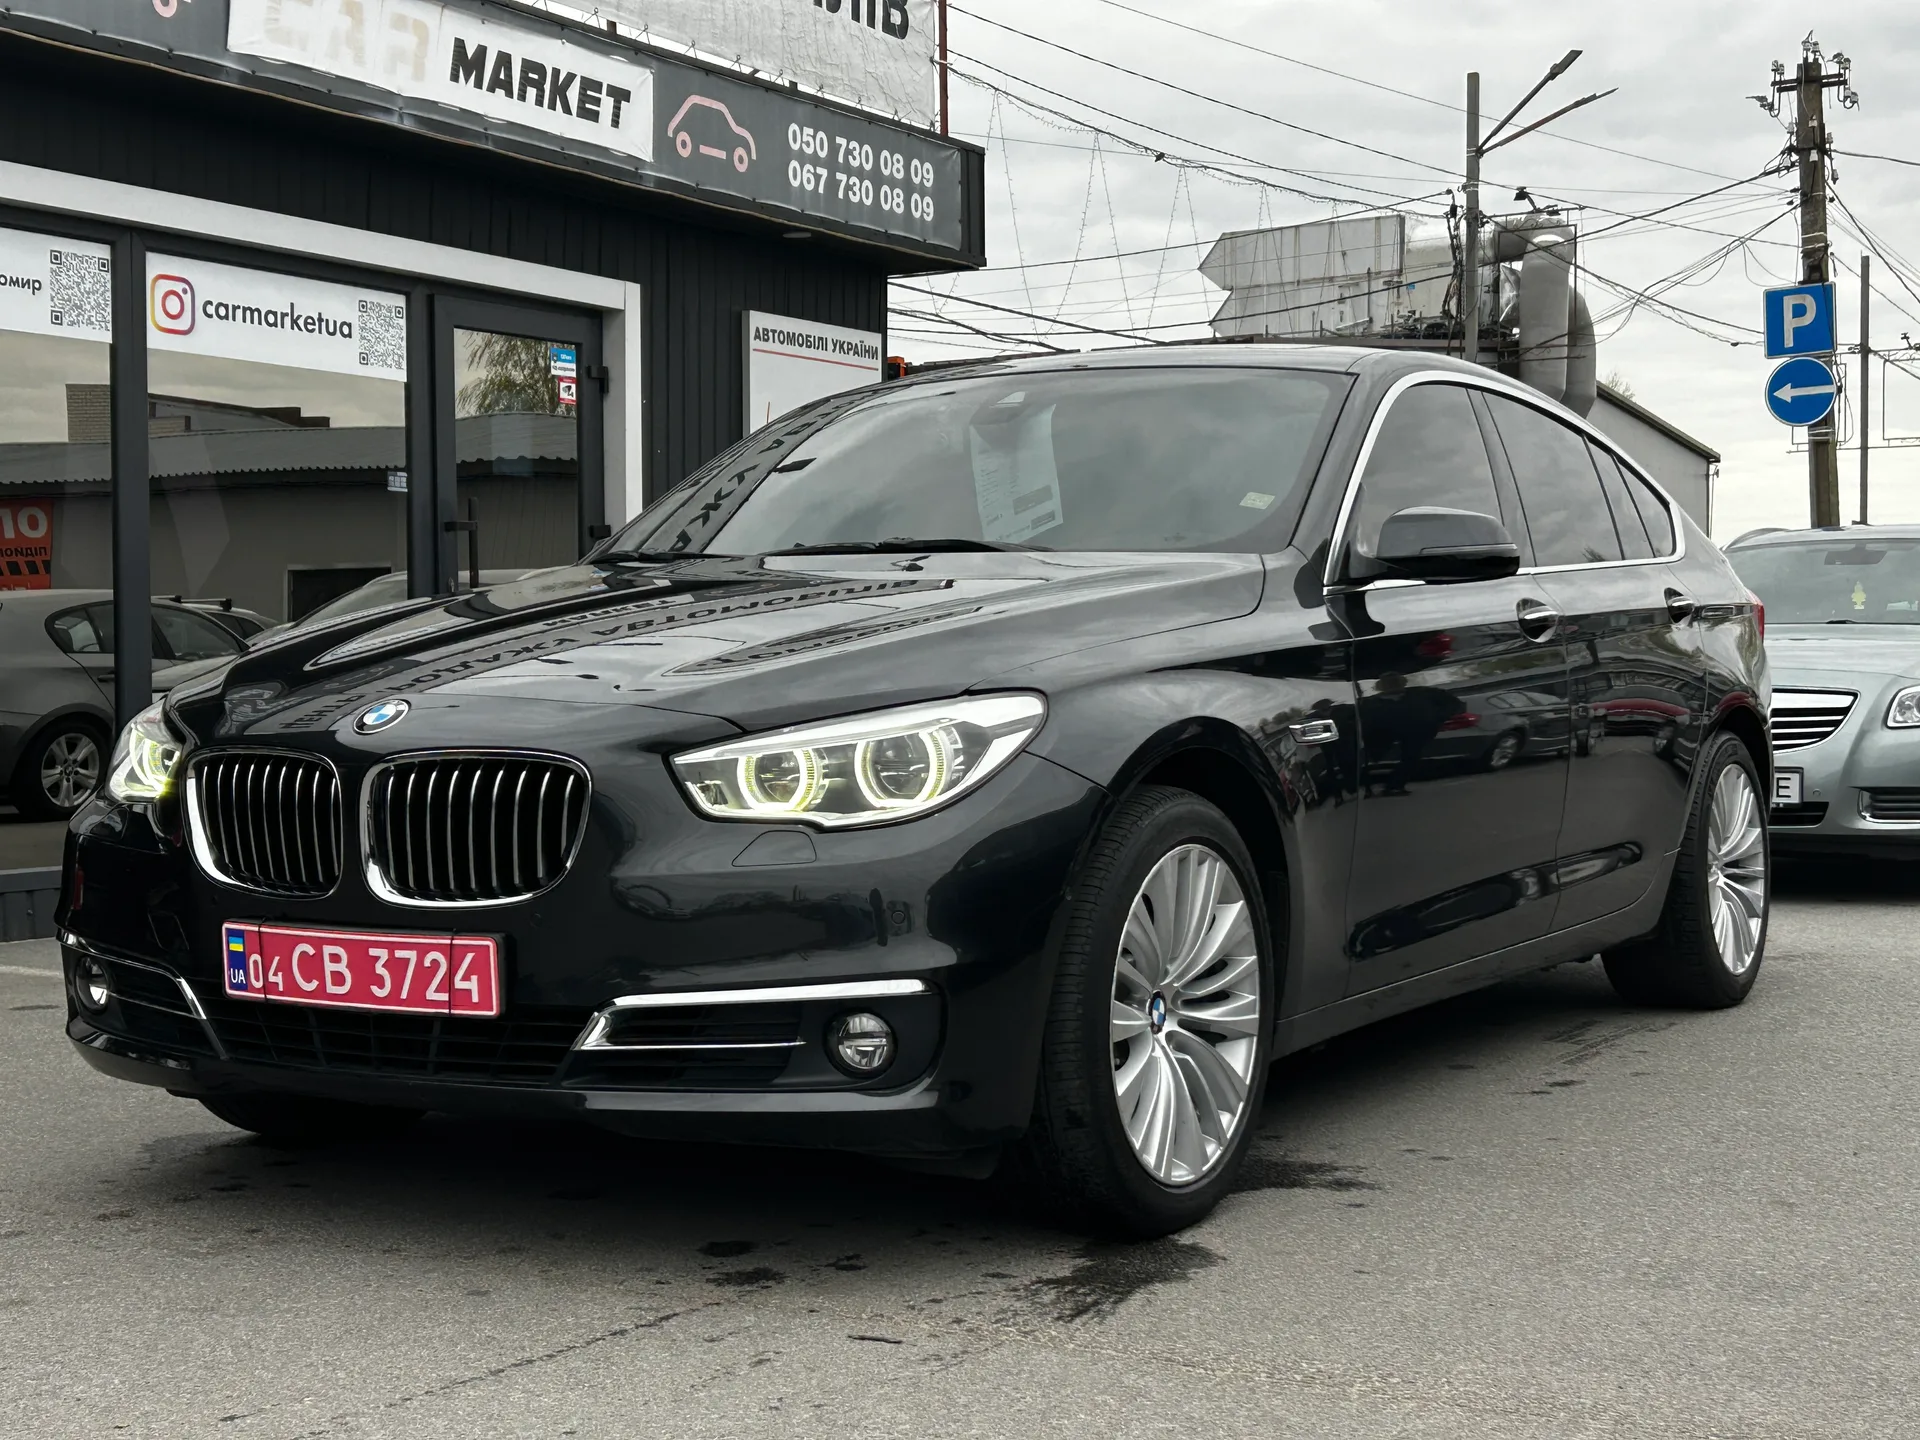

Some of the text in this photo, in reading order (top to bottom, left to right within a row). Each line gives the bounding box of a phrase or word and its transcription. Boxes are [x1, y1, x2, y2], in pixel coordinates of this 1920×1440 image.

[449, 36, 632, 129] MARKET
[788, 122, 934, 188] 050 730 08 09
[788, 159, 934, 222] 067 730 08 09
[202, 299, 353, 340] carmarketua
[753, 326, 879, 361] АВТОМОБІЛІ УКРАЇНИ
[1782, 293, 1817, 348] P
[230, 967, 247, 985] UA
[367, 947, 479, 1003] 3724
